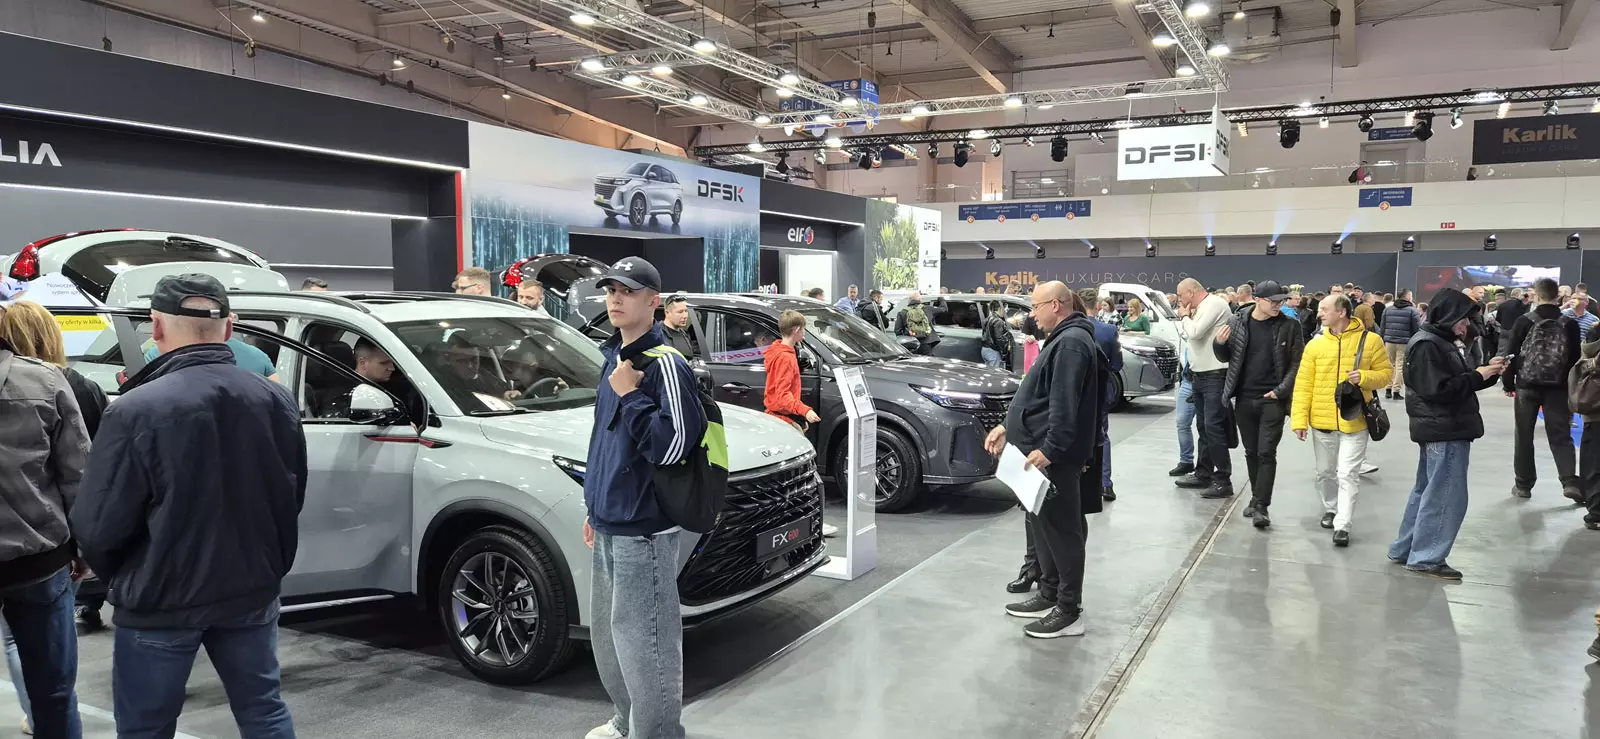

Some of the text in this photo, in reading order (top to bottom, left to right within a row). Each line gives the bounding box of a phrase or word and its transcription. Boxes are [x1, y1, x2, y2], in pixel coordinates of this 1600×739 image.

[1503, 124, 1577, 143] Karlik
[697, 179, 744, 203] DFSK
[788, 227, 805, 242] elf
[985, 271, 1040, 285] Karlik
